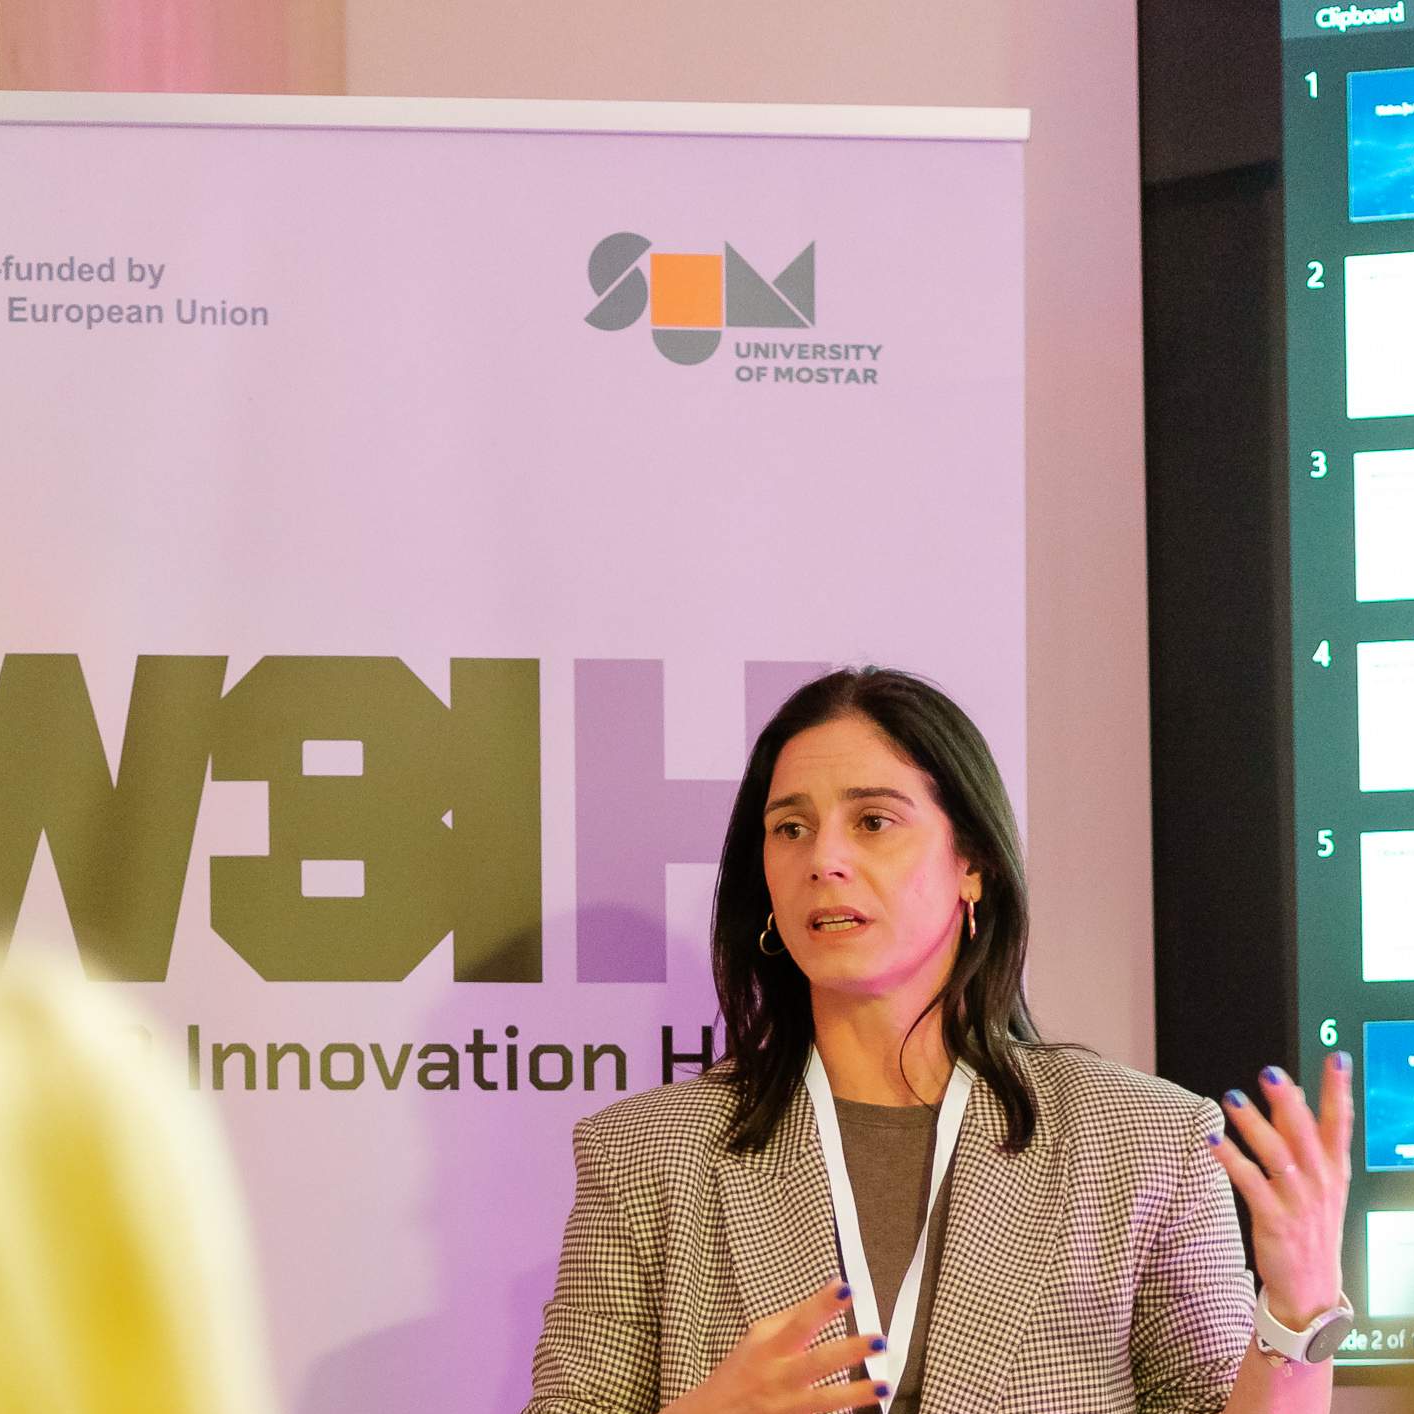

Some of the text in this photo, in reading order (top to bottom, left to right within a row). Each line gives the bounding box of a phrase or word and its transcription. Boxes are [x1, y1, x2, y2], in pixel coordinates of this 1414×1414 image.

[1315, 1, 1405, 32] Clipboard
[1305, 71, 1318, 98] 1
[127, 257, 166, 290] by
[1306, 261, 1325, 289] 2
[8, 296, 163, 330] European
[176, 298, 269, 326] Union
[735, 341, 883, 361] UNIVERSITY
[735, 365, 878, 385] OF MOSTAR
[1310, 450, 1328, 479] 3
[1312, 640, 1332, 667] 4
[1317, 829, 1335, 858] 5
[1320, 1019, 1339, 1046] 6
[187, 1024, 627, 1092] Innovation
[1371, 1330, 1383, 1350] 2
[1387, 1329, 1406, 1349] of
